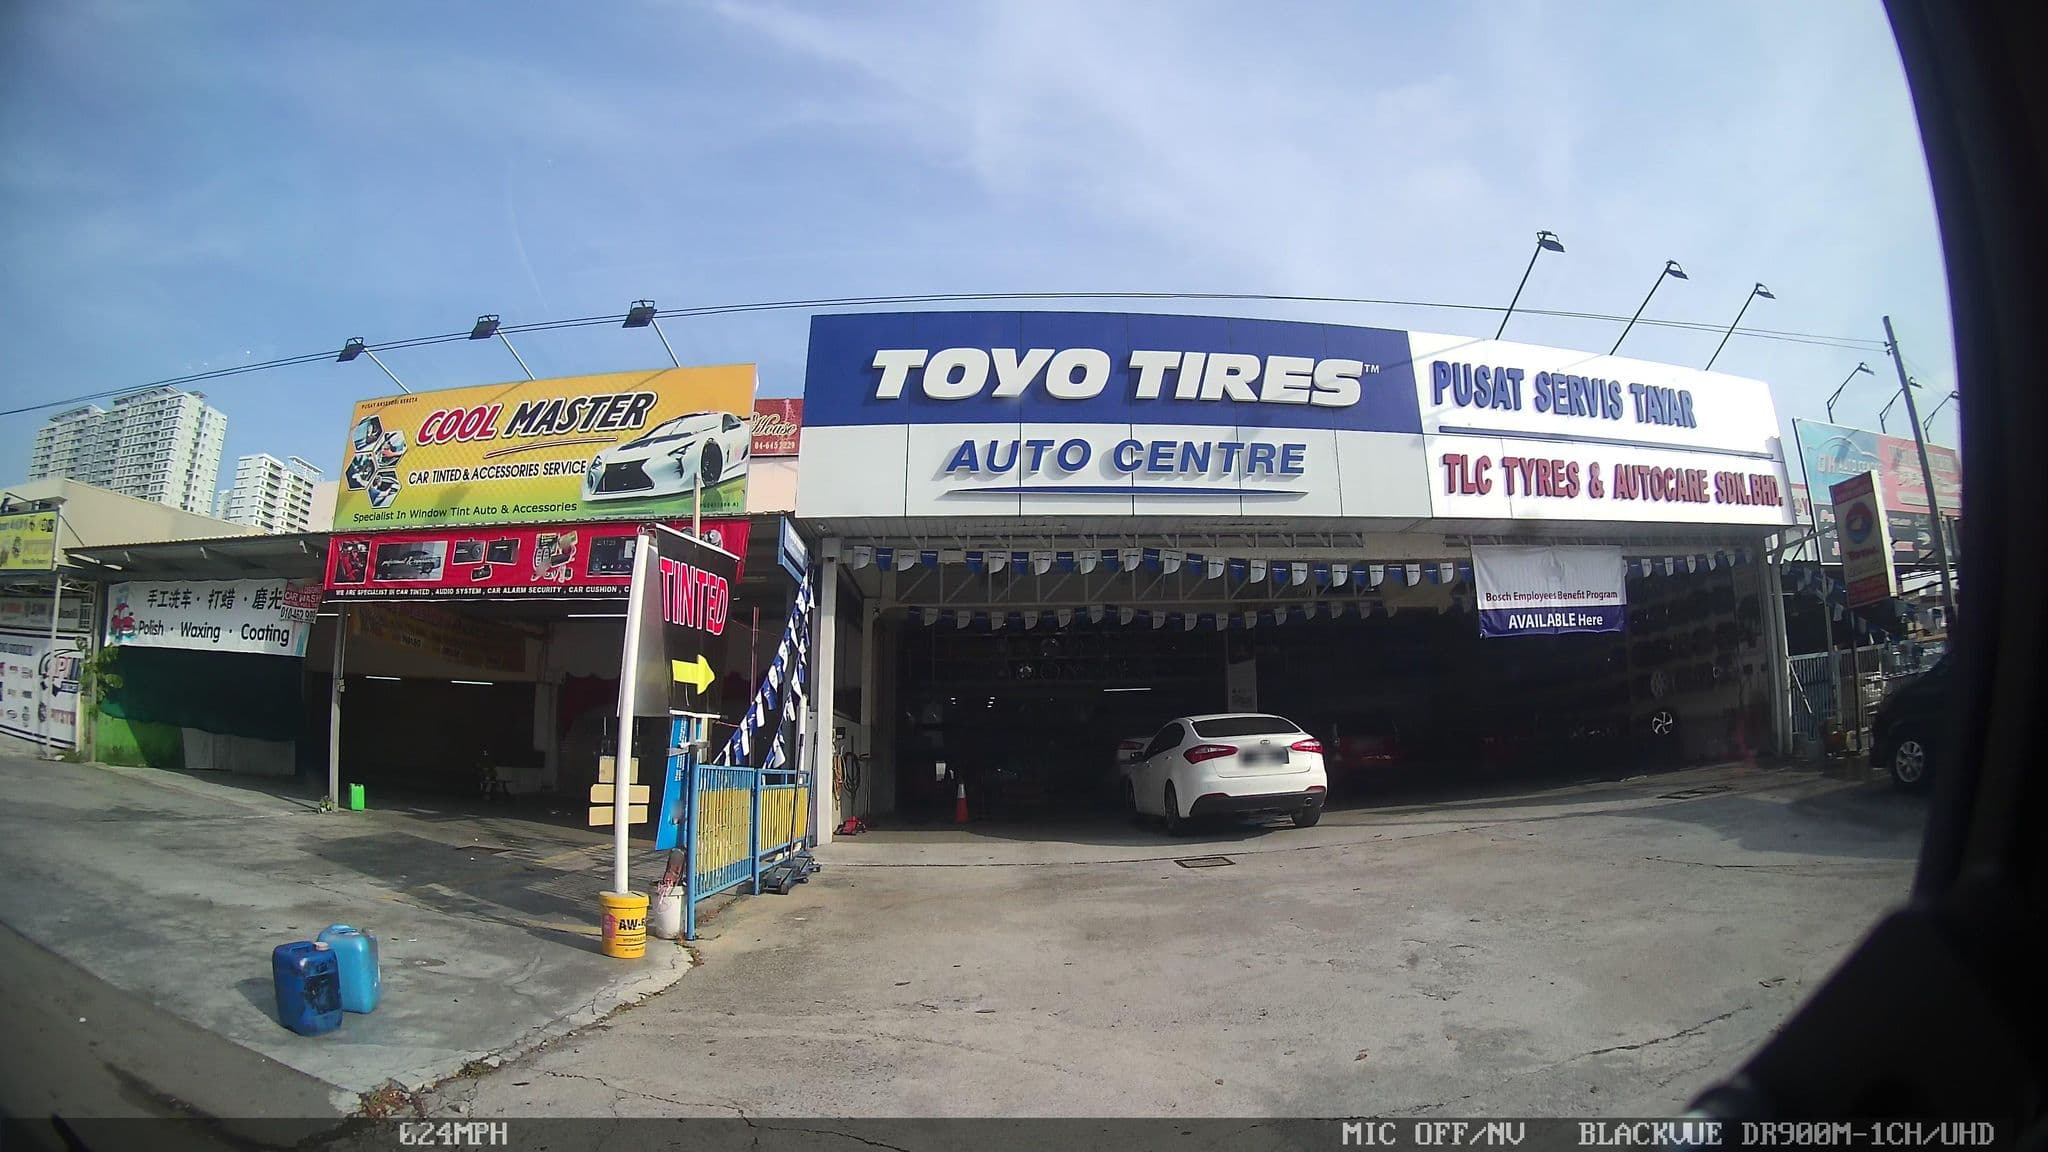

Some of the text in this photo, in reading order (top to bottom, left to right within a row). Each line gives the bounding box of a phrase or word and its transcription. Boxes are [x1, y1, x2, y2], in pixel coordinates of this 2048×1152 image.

[872, 347, 1112, 400] TOYO
[1128, 350, 1364, 407] TIRES
[1432, 360, 1697, 429] PUSAT SERVIS TAYAR
[416, 392, 658, 445] COOL MASTER
[408, 460, 587, 485] CAR TINTED & ACCESSORIES SERVICE
[945, 438, 1307, 475] AUTO CENTRE
[1442, 453, 1493, 495] TLC
[1502, 456, 1580, 499] TYRES
[1589, 461, 1605, 499] &
[1613, 463, 1711, 504] AUTOCARE
[353, 502, 577, 523] Specialist In Window Tint Auto & Accessories
[503, 586, 527, 594] ALARM
[528, 586, 562, 594] SECURITY
[660, 557, 729, 636] TINTED
[1485, 589, 1618, 602] Bosch Employees Benefit Program
[139, 620, 290, 647] Polish Waxing Coating
[1508, 612, 1603, 630] AVAILABLE Here
